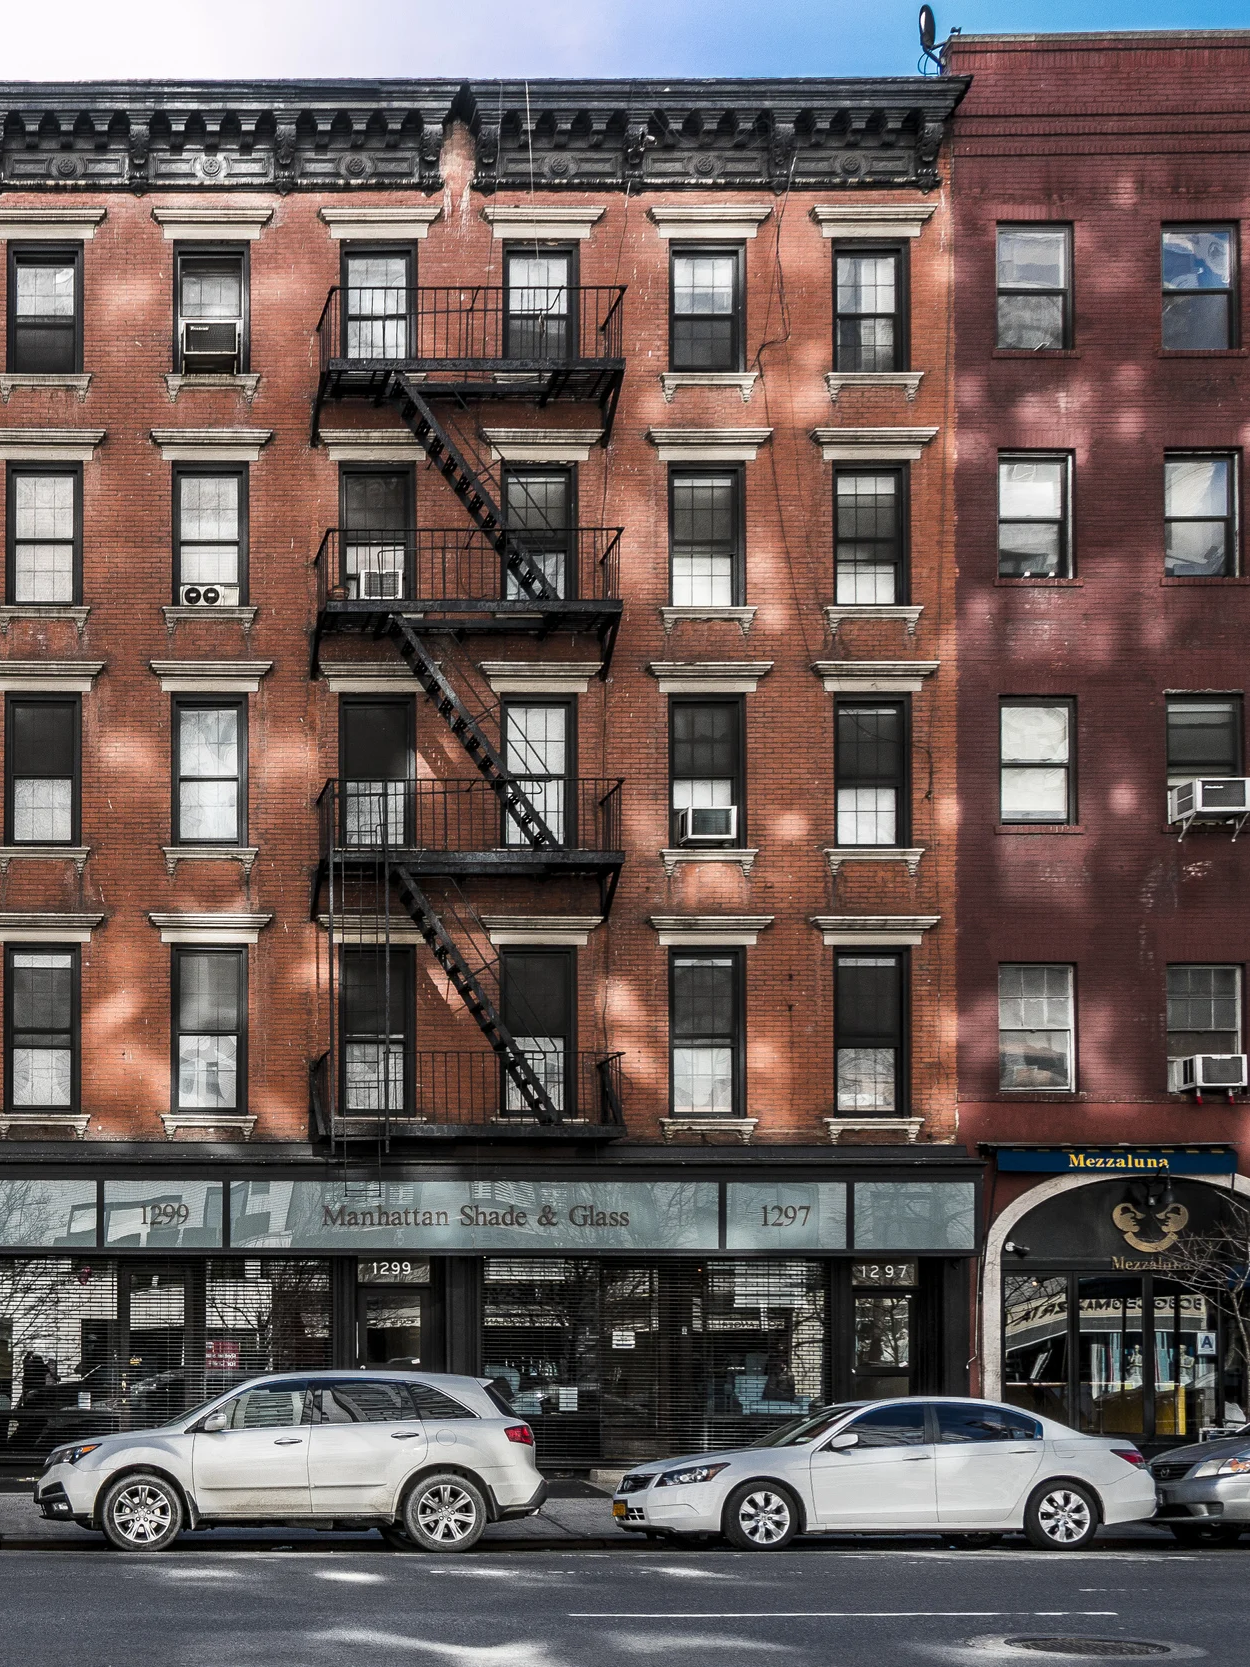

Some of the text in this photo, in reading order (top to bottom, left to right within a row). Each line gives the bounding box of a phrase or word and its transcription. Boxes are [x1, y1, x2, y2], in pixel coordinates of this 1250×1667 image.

[1068, 1153, 1170, 1169] Mezzaluna
[140, 1203, 190, 1226] 1299
[322, 1204, 630, 1227] Manhattan Shade & Glass
[761, 1204, 811, 1227] 1297
[372, 1262, 411, 1275] 1299
[861, 1265, 907, 1278] 1297
[1201, 1336, 1213, 1349] A
